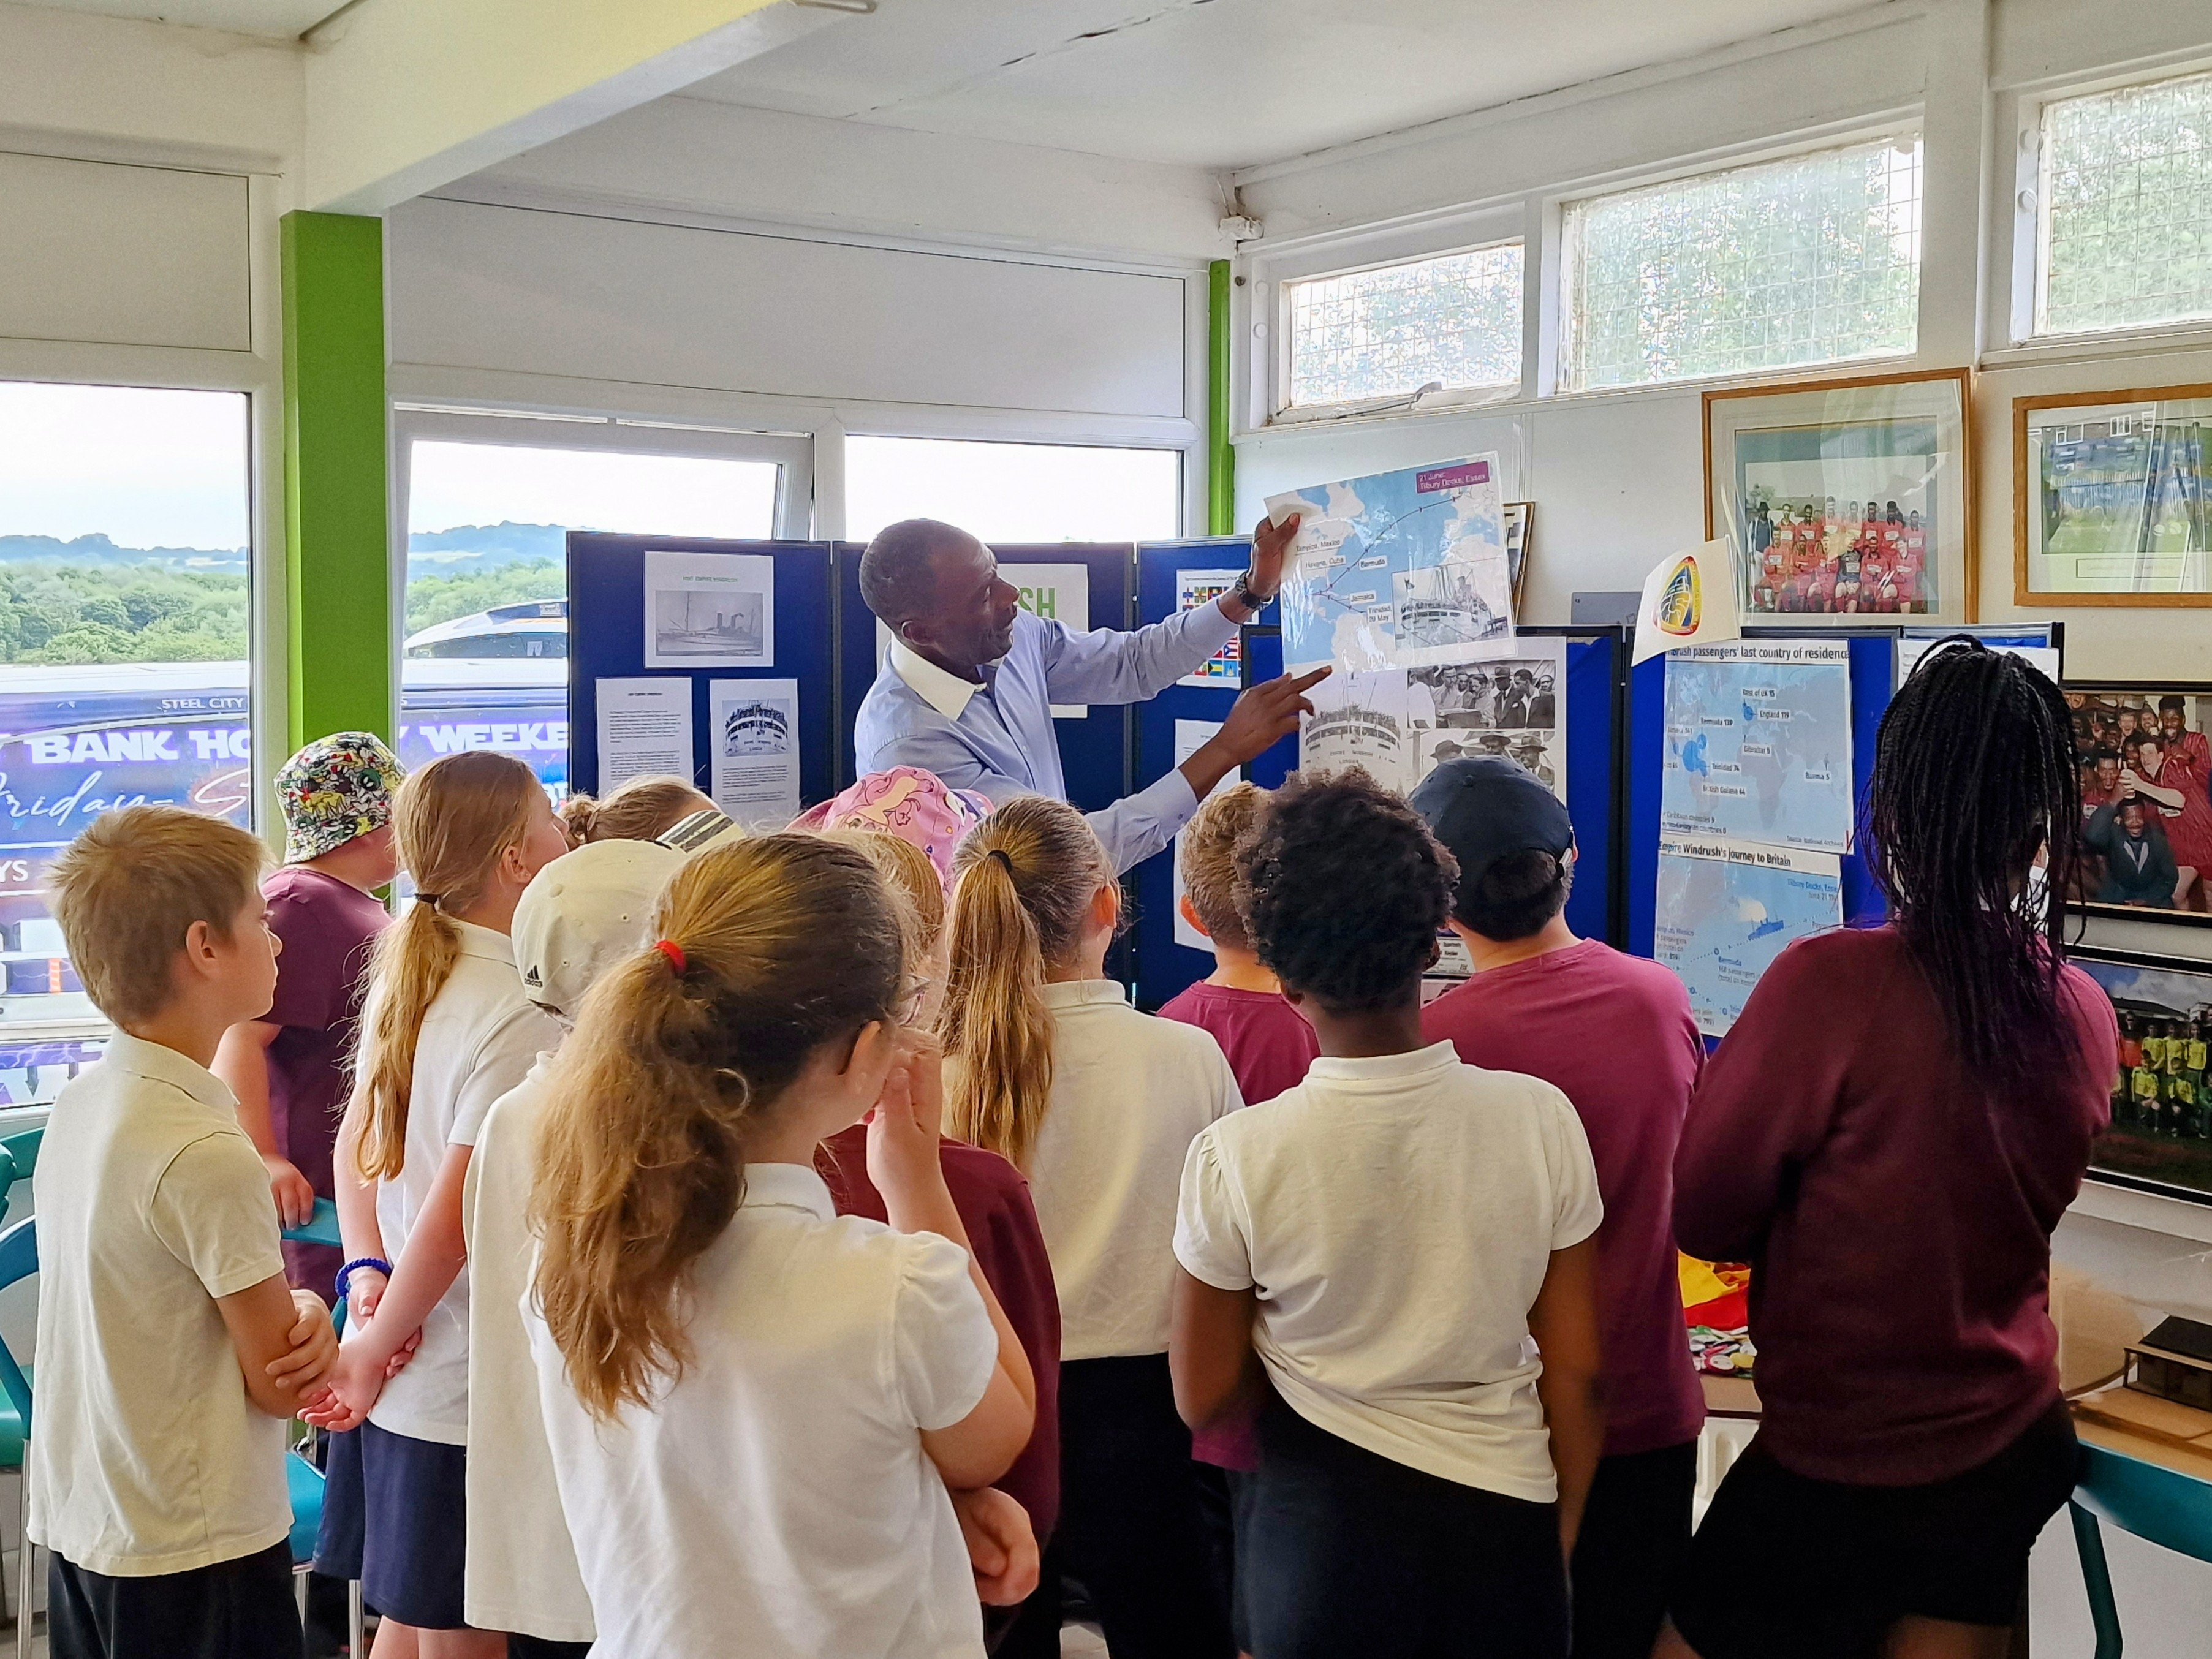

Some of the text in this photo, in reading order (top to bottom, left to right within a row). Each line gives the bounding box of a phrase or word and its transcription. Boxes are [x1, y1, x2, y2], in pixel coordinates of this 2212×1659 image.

[1693, 646, 1739, 660] passengers'
[1741, 645, 1757, 657] last
[1759, 647, 1790, 661] country
[1793, 647, 1803, 659] of
[162, 697, 244, 710] STEEL CITY
[23, 730, 179, 765] BANK
[1683, 842, 1727, 857] Windrush's
[1757, 853, 1765, 863] to
[1767, 853, 1791, 867] Britain
